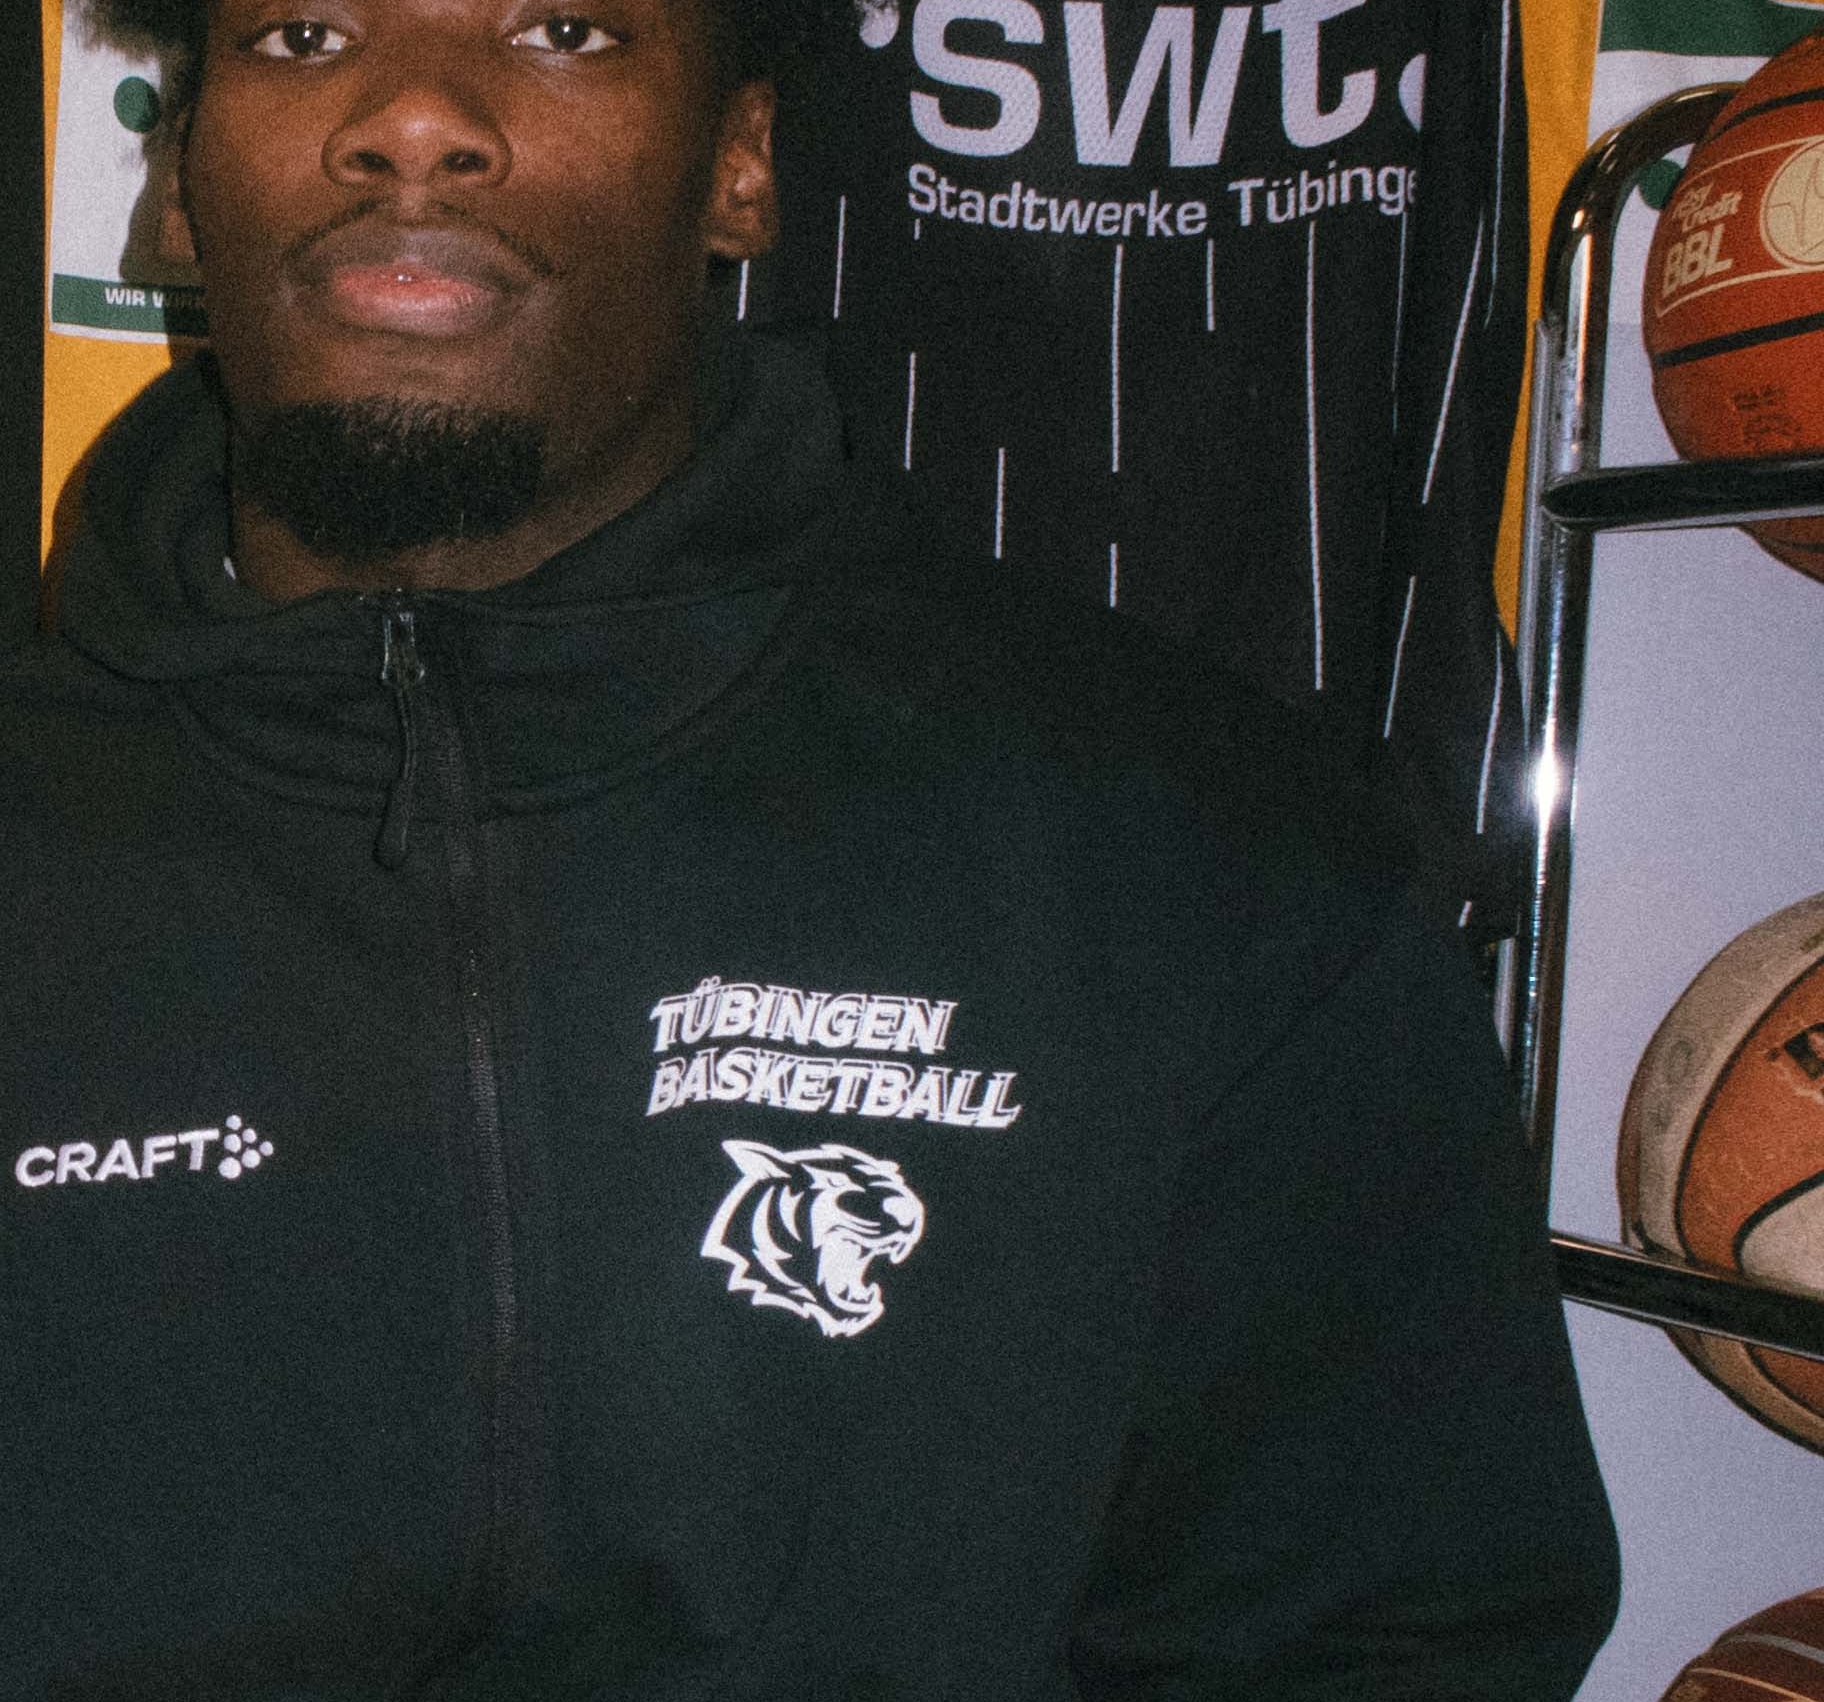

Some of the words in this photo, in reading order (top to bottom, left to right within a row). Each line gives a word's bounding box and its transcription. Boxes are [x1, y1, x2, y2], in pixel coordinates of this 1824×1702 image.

[908, 162, 1207, 237] Stadtwerke
[1662, 223, 1734, 297] BBL
[104, 287, 146, 308] WIR
[649, 975, 958, 1055] TÜBINGEN
[645, 1046, 1021, 1129] BASKETBALL
[15, 1126, 220, 1188] CRAFT
